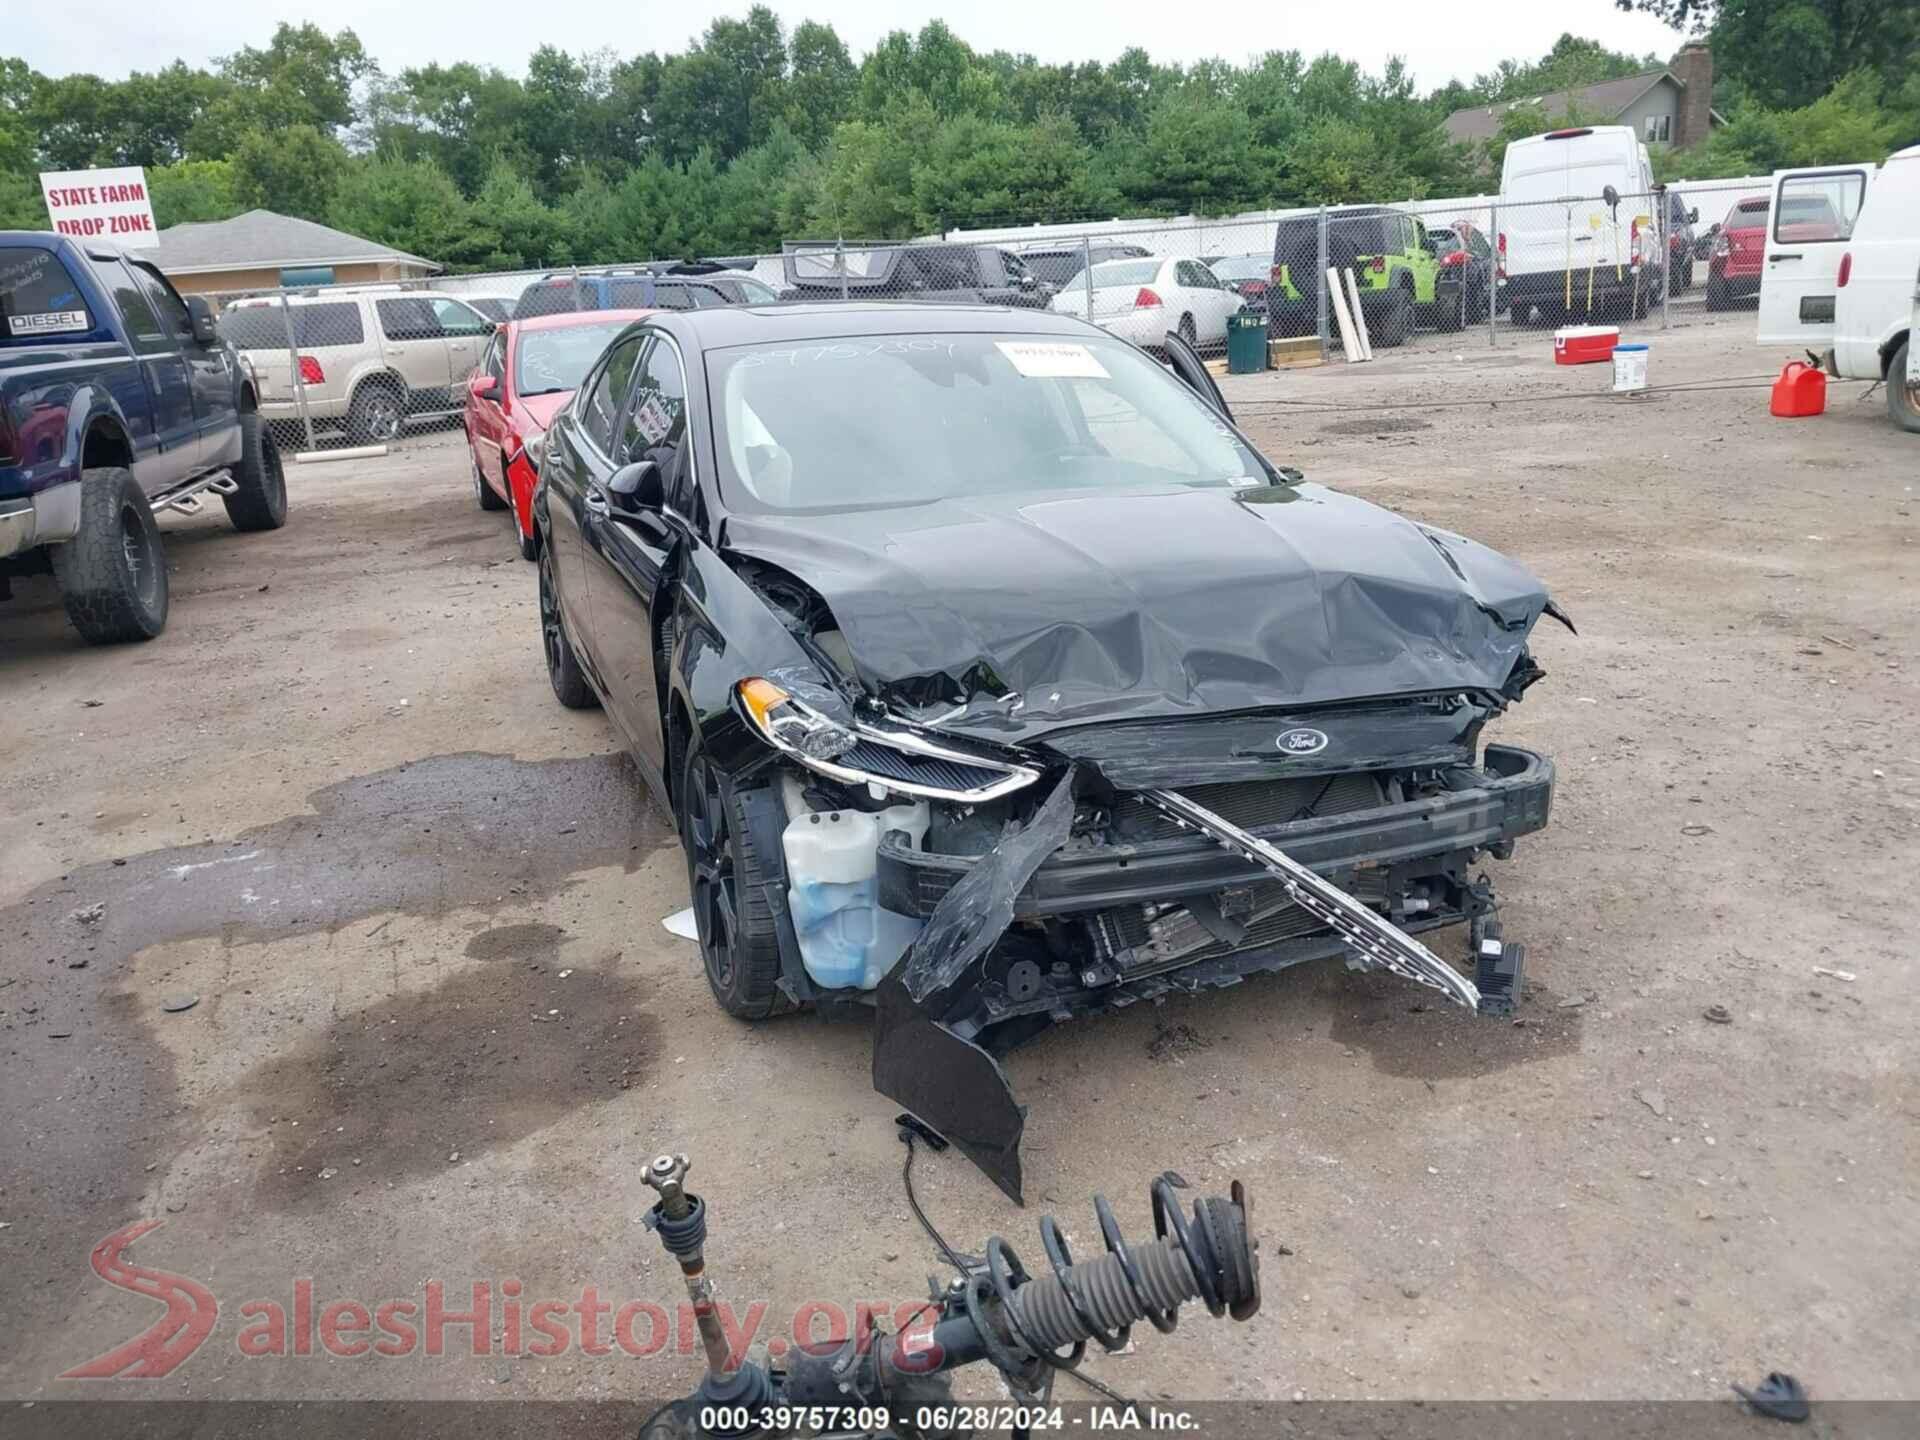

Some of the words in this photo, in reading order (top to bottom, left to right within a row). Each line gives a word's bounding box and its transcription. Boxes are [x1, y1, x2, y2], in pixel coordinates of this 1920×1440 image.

[49, 187, 98, 208] STATE
[100, 183, 145, 203] FARM
[57, 218, 105, 237] DROP
[108, 214, 152, 233] ZONE
[11, 312, 83, 328] DIESEL
[1288, 733, 1318, 749] Ford
